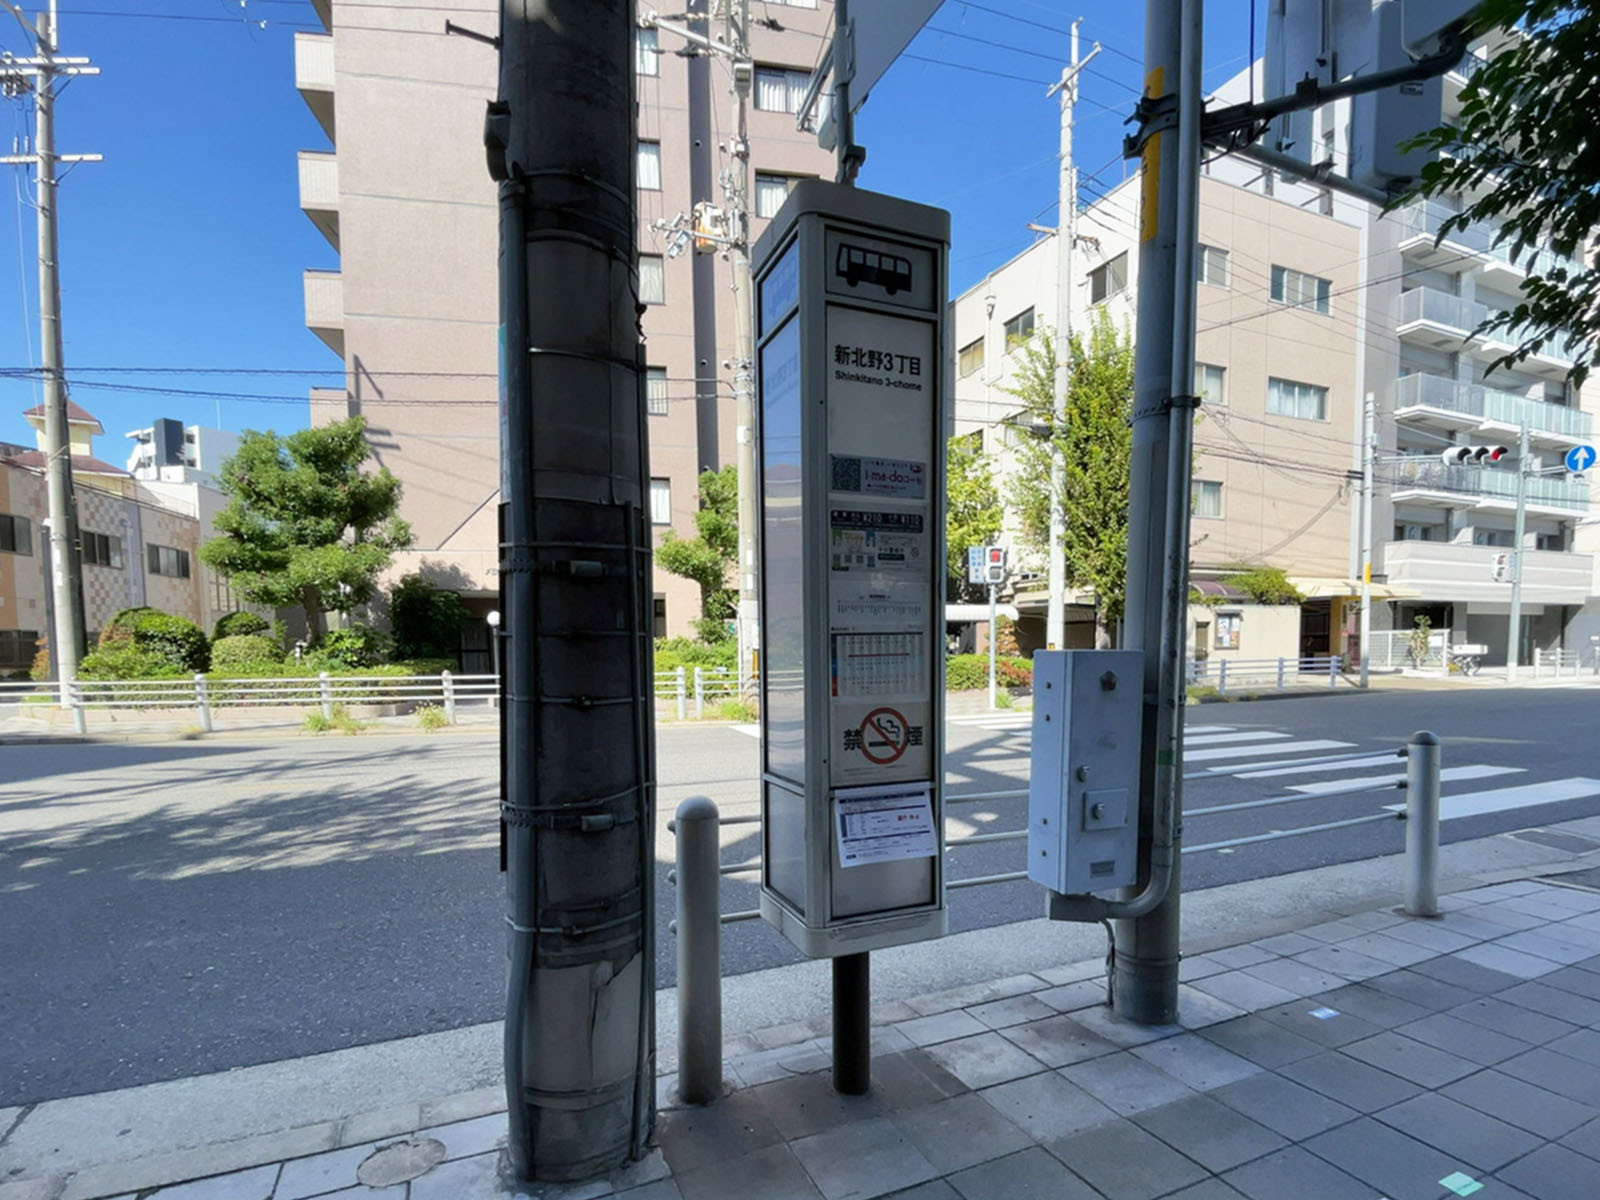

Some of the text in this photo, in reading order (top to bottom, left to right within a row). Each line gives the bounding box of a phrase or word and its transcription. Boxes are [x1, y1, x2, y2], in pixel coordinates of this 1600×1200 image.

[834, 344, 921, 376] 新北野3丁目
[835, 369, 923, 392] Shinkitano 3-chome
[843, 728, 863, 751] 禁
